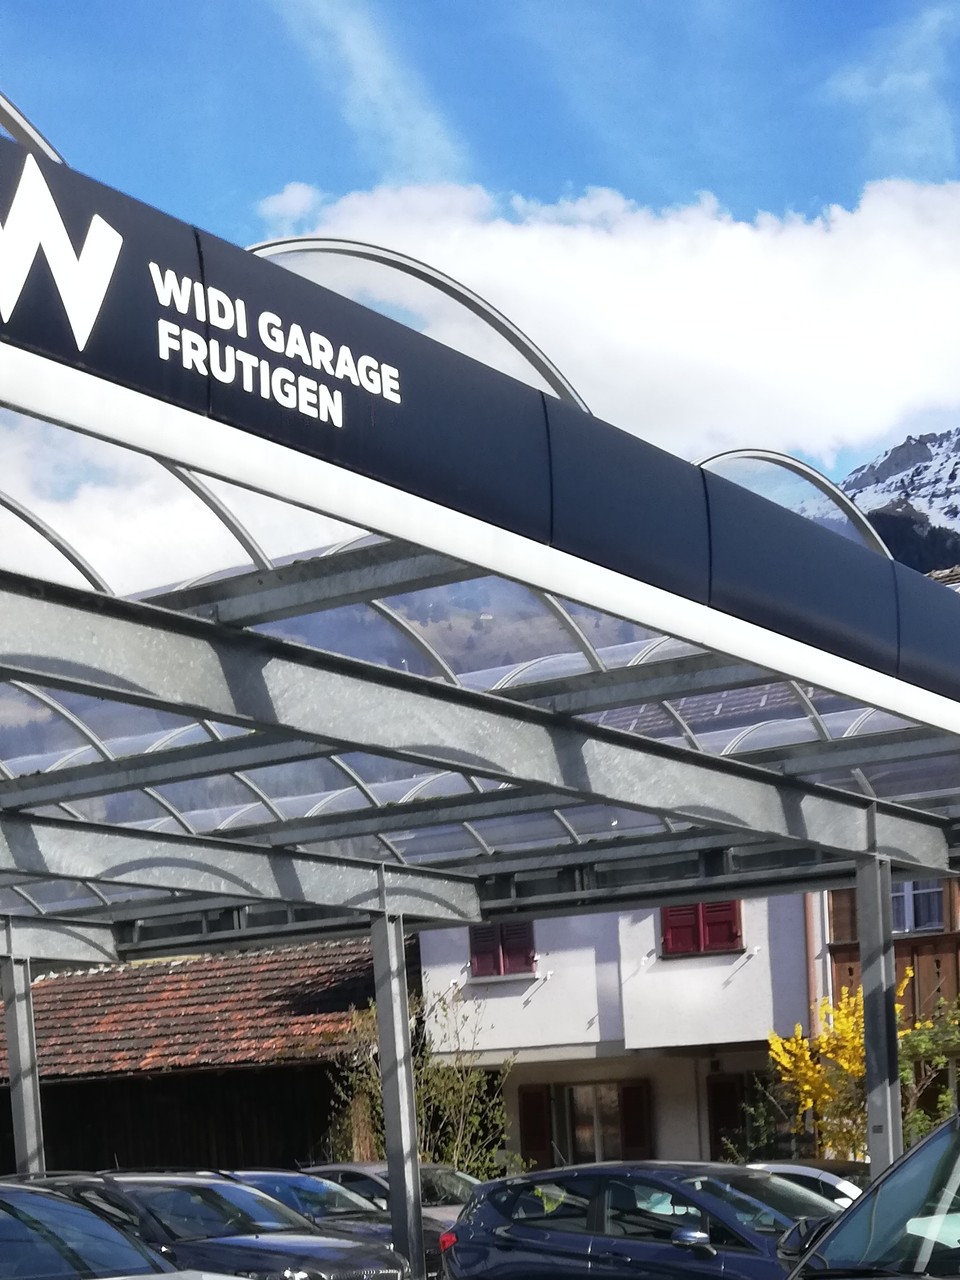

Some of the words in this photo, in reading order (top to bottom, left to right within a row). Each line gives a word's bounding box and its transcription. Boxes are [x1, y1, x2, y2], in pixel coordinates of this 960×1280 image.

[148, 261, 248, 339] WIDI
[257, 311, 402, 404] GARAGE
[157, 318, 343, 428] FRUTIGEN
